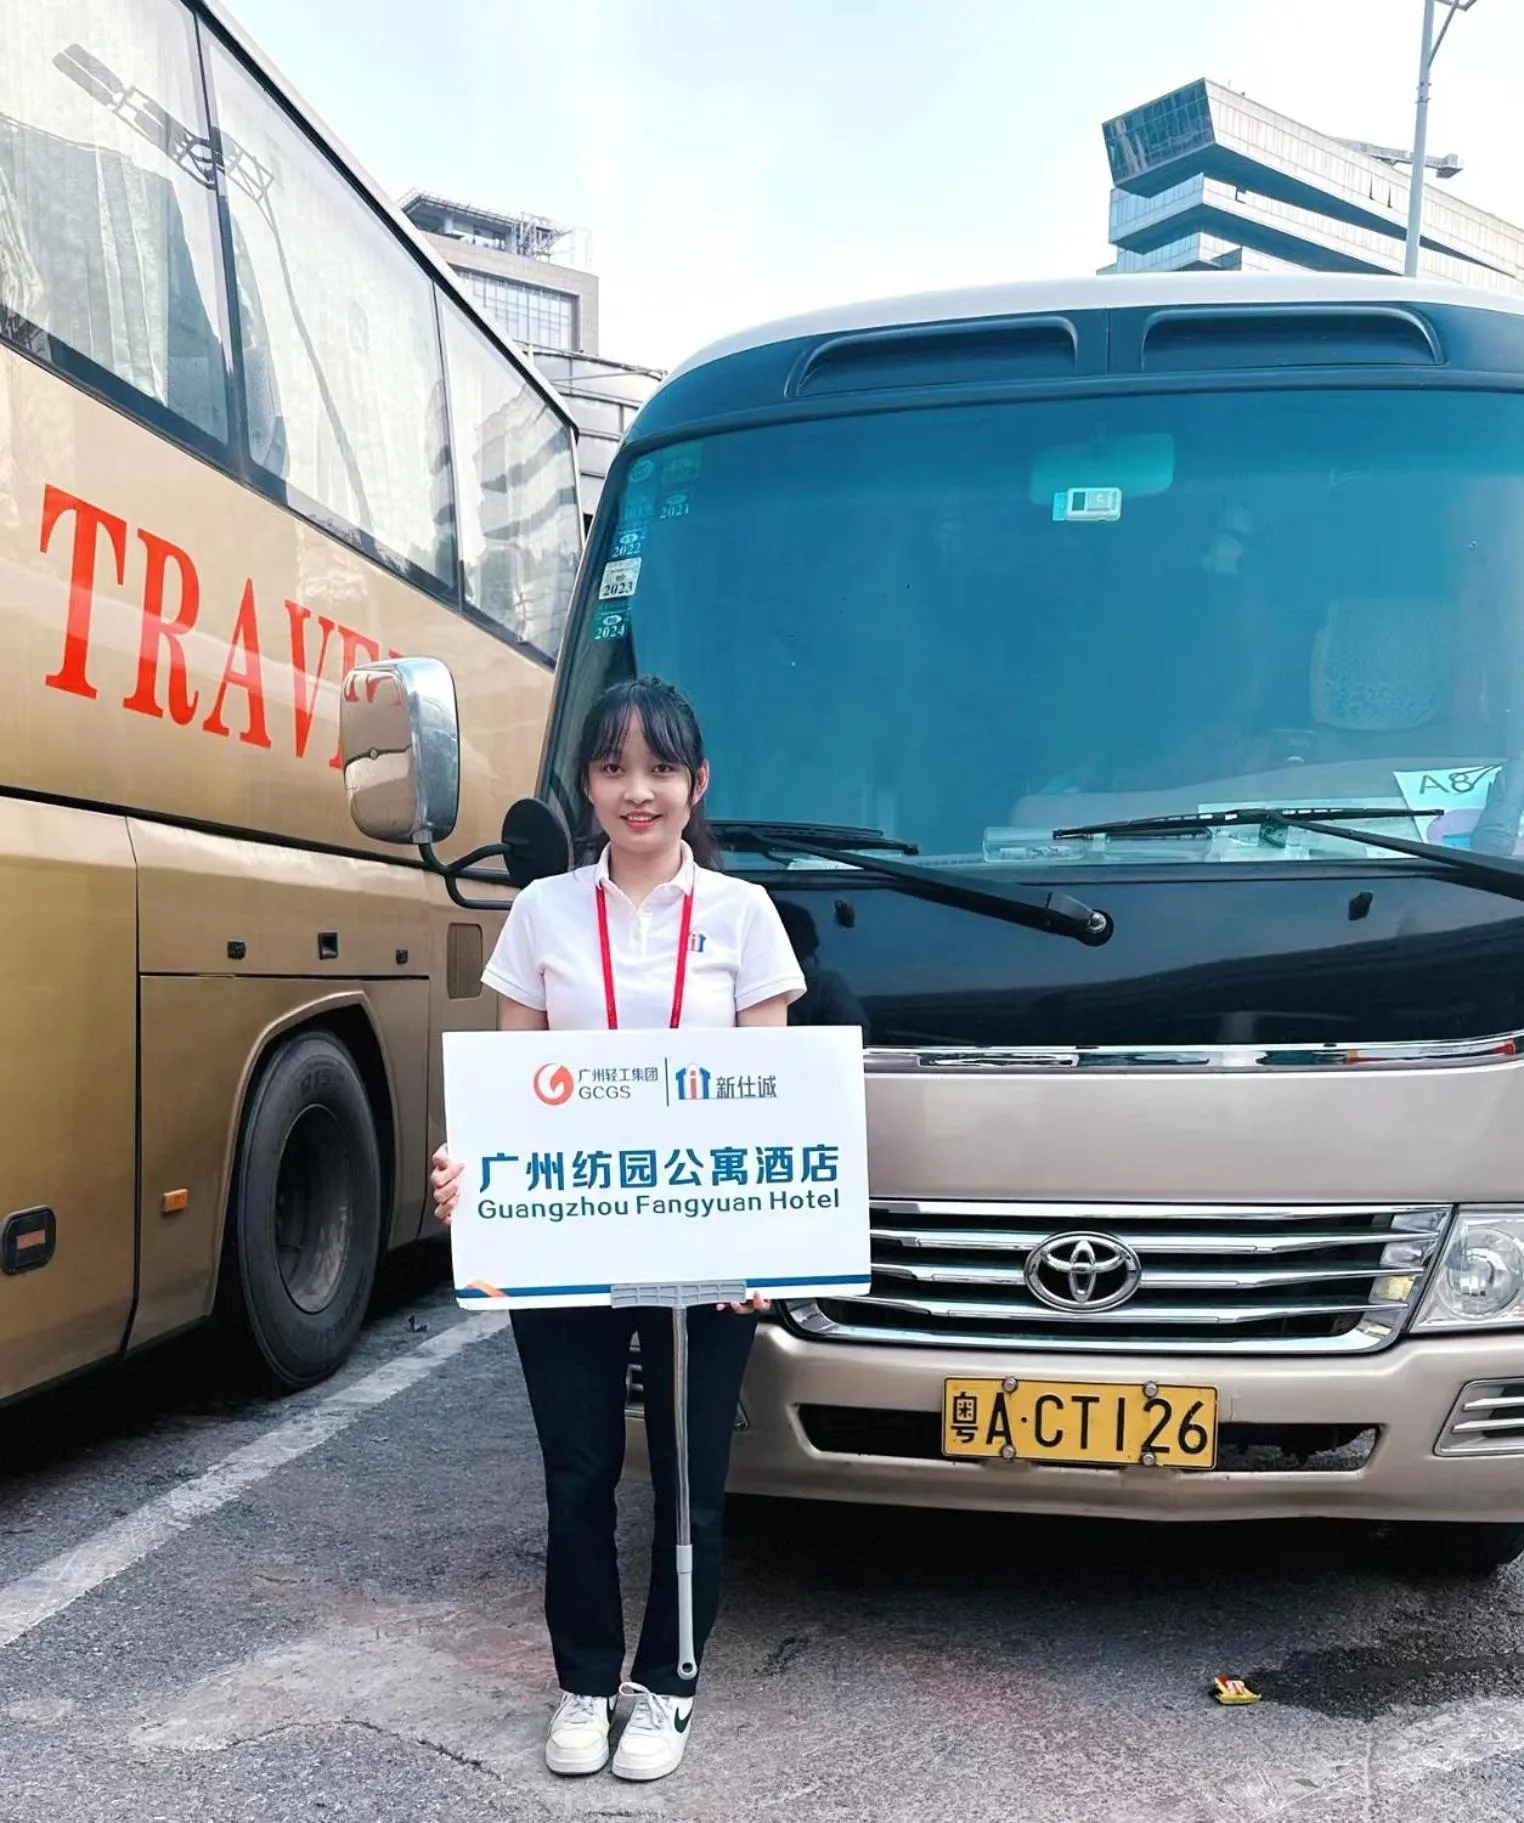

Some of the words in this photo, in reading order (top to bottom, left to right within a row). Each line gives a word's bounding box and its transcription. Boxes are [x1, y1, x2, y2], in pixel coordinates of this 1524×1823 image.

[612, 543, 641, 558] 2022
[603, 581, 634, 596] 2023
[40, 484, 403, 769] TRAV
[594, 624, 626, 640] 2024
[578, 1067, 659, 1083] 广州轻工集团
[579, 1085, 631, 1100] GCGS
[716, 1075, 777, 1099] 新仕诚
[480, 1144, 839, 1194] 广州纺园公寓酒店
[478, 1196, 628, 1222] Guangzhou
[636, 1193, 762, 1218] Fangyuan
[770, 1188, 840, 1211] Hotel
